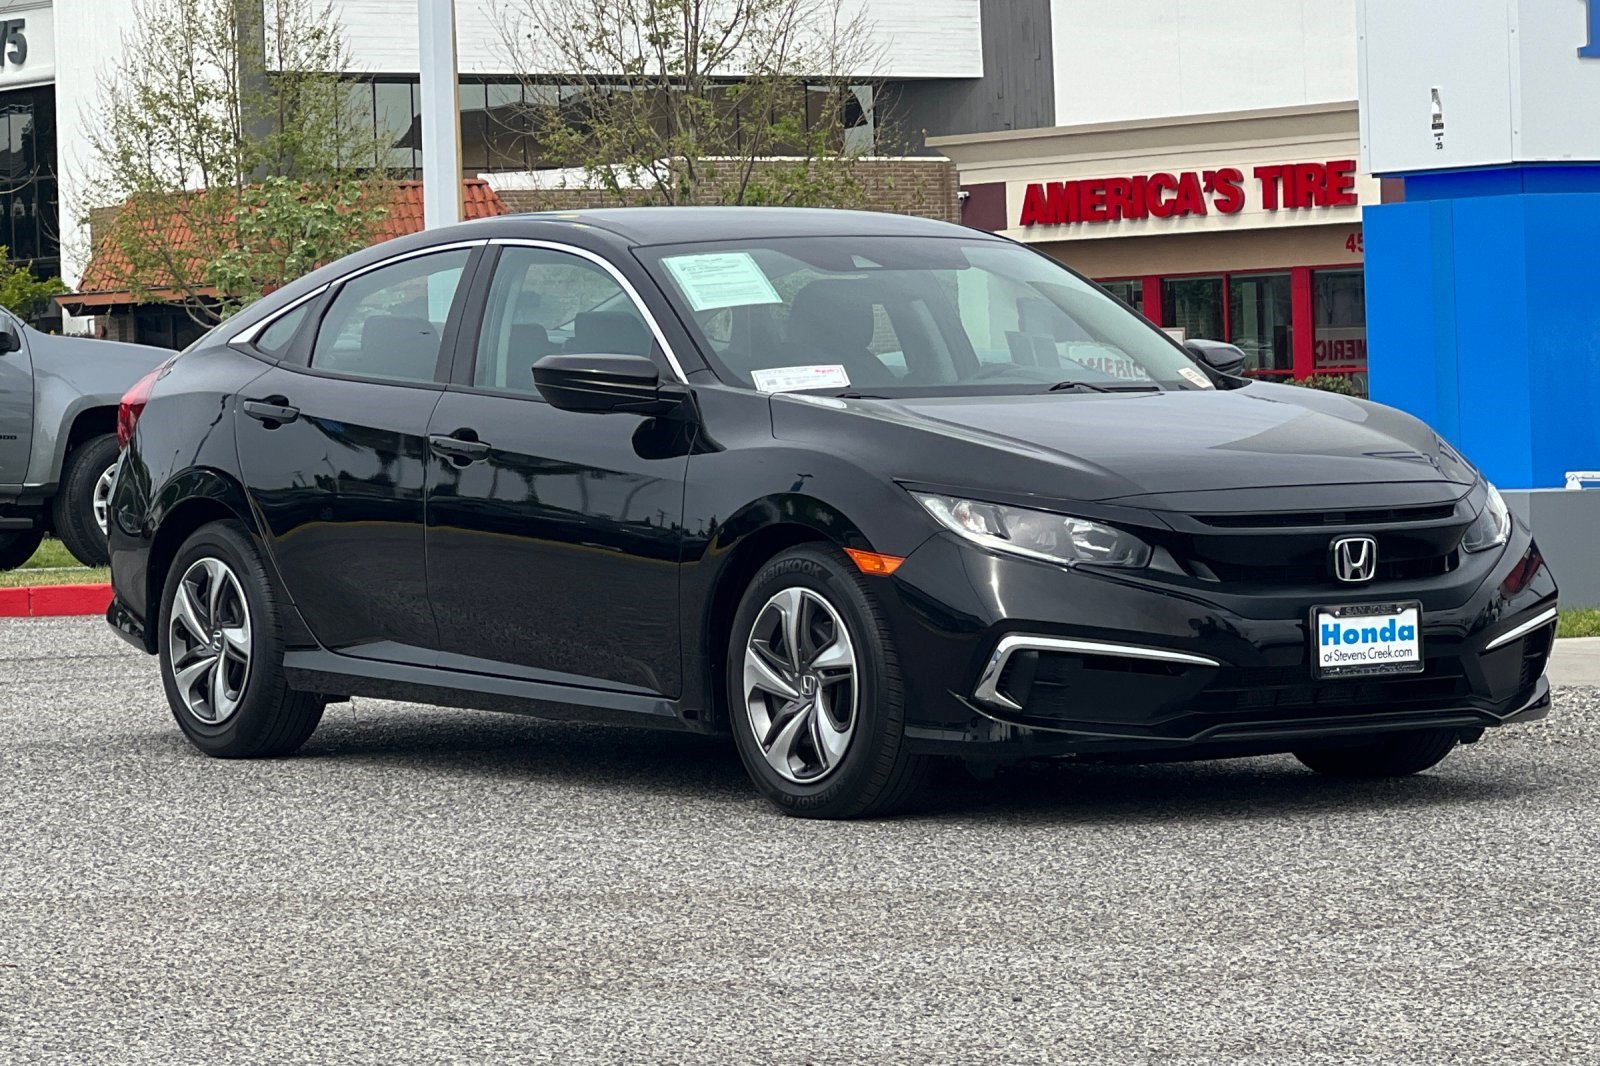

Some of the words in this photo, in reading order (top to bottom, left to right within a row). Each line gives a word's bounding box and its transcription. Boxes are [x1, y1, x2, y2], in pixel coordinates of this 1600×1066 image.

[1019, 167, 1246, 226] AMERICA'S
[1254, 160, 1359, 211] TIRE
[1321, 619, 1415, 646] Honda
[1323, 651, 1334, 662] of
[1334, 649, 1367, 661] Stevens
[1367, 645, 1413, 660] Creek.com
